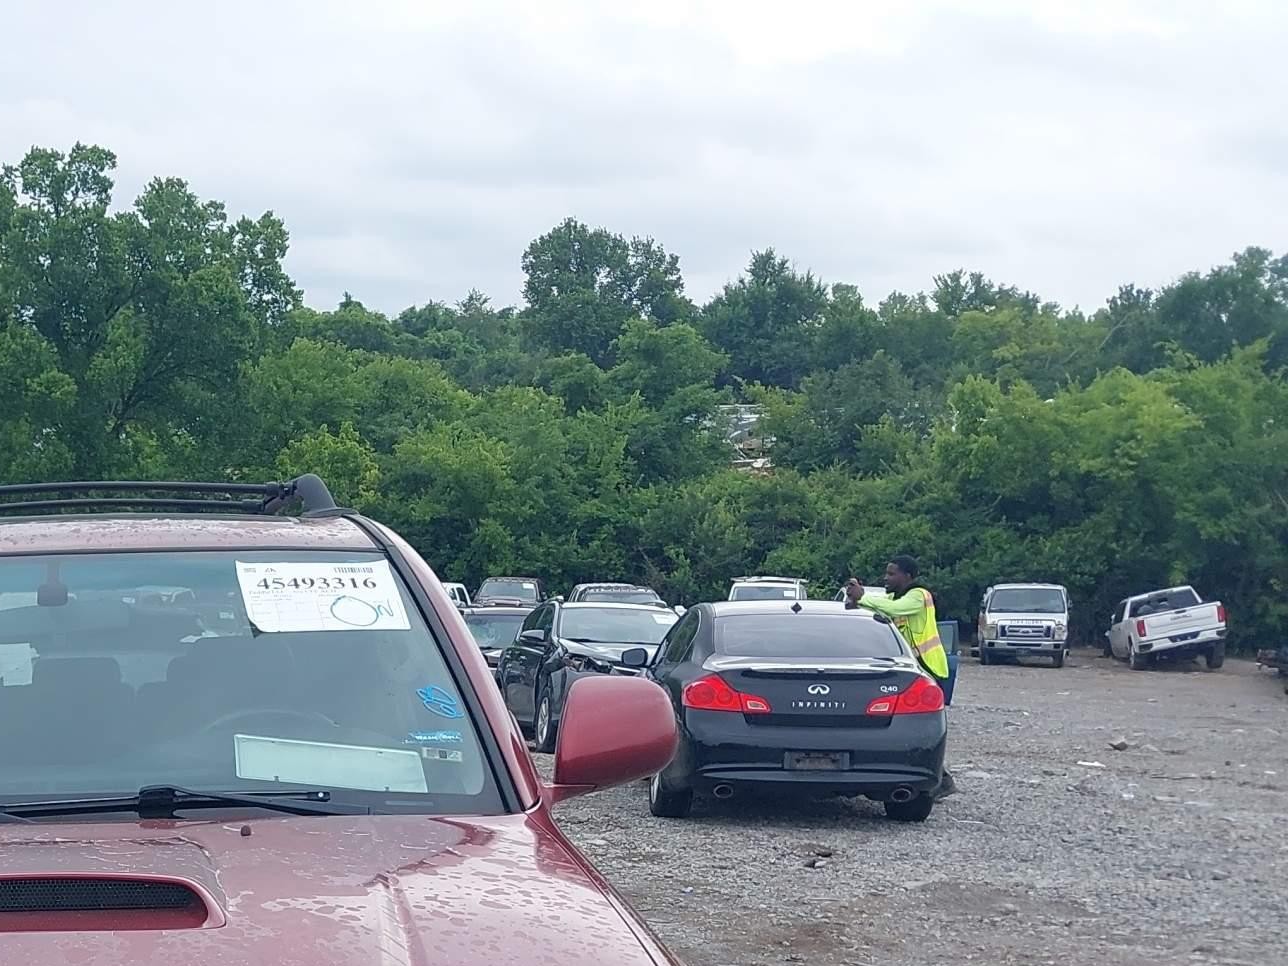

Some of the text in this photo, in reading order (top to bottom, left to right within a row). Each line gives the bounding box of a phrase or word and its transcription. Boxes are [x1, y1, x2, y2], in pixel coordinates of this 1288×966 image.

[256, 577, 377, 591] 45493316
[880, 685, 898, 693] Q40
[791, 701, 846, 709] INFINITI
